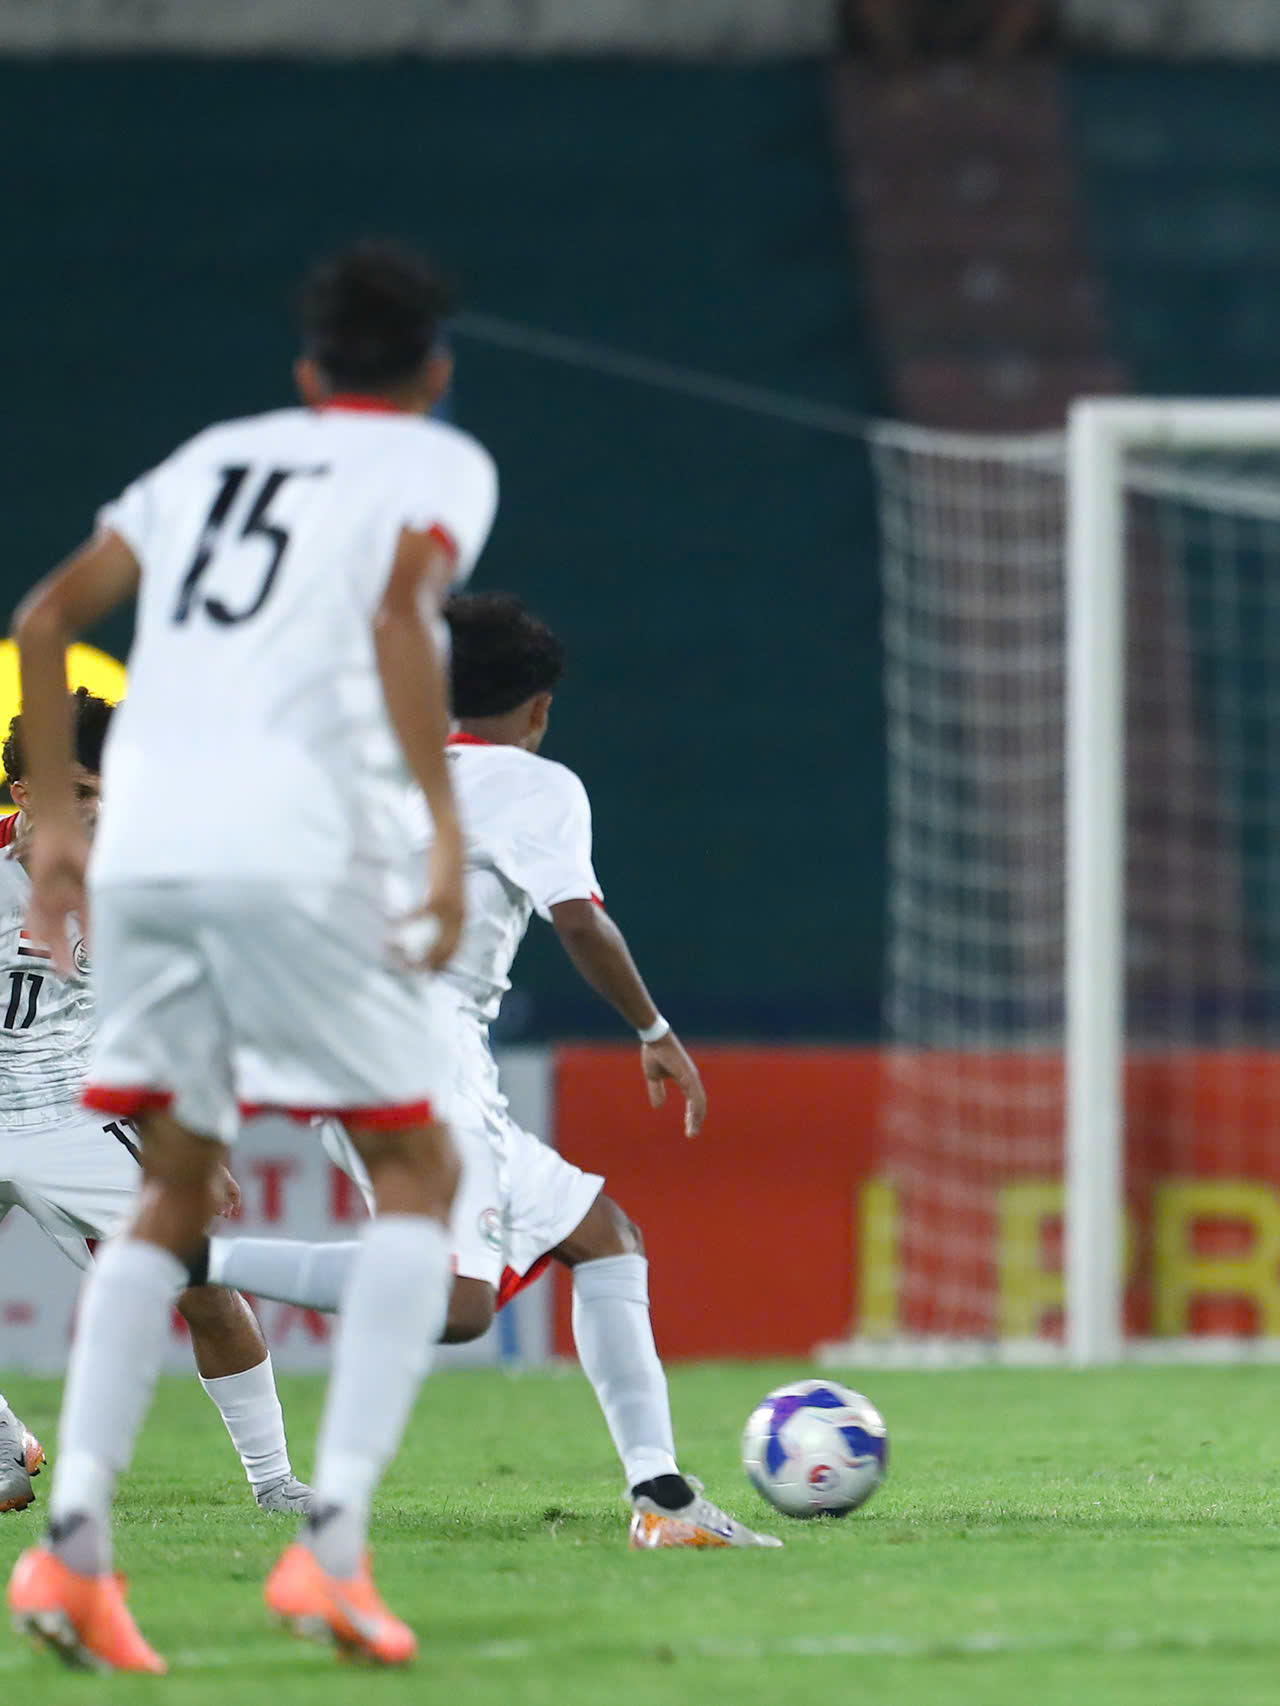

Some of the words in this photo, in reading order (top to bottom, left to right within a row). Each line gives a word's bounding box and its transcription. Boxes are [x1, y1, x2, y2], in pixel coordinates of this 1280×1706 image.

[174, 464, 330, 626] 15
[4, 971, 44, 1029] 11
[102, 1119, 143, 1168] 1
